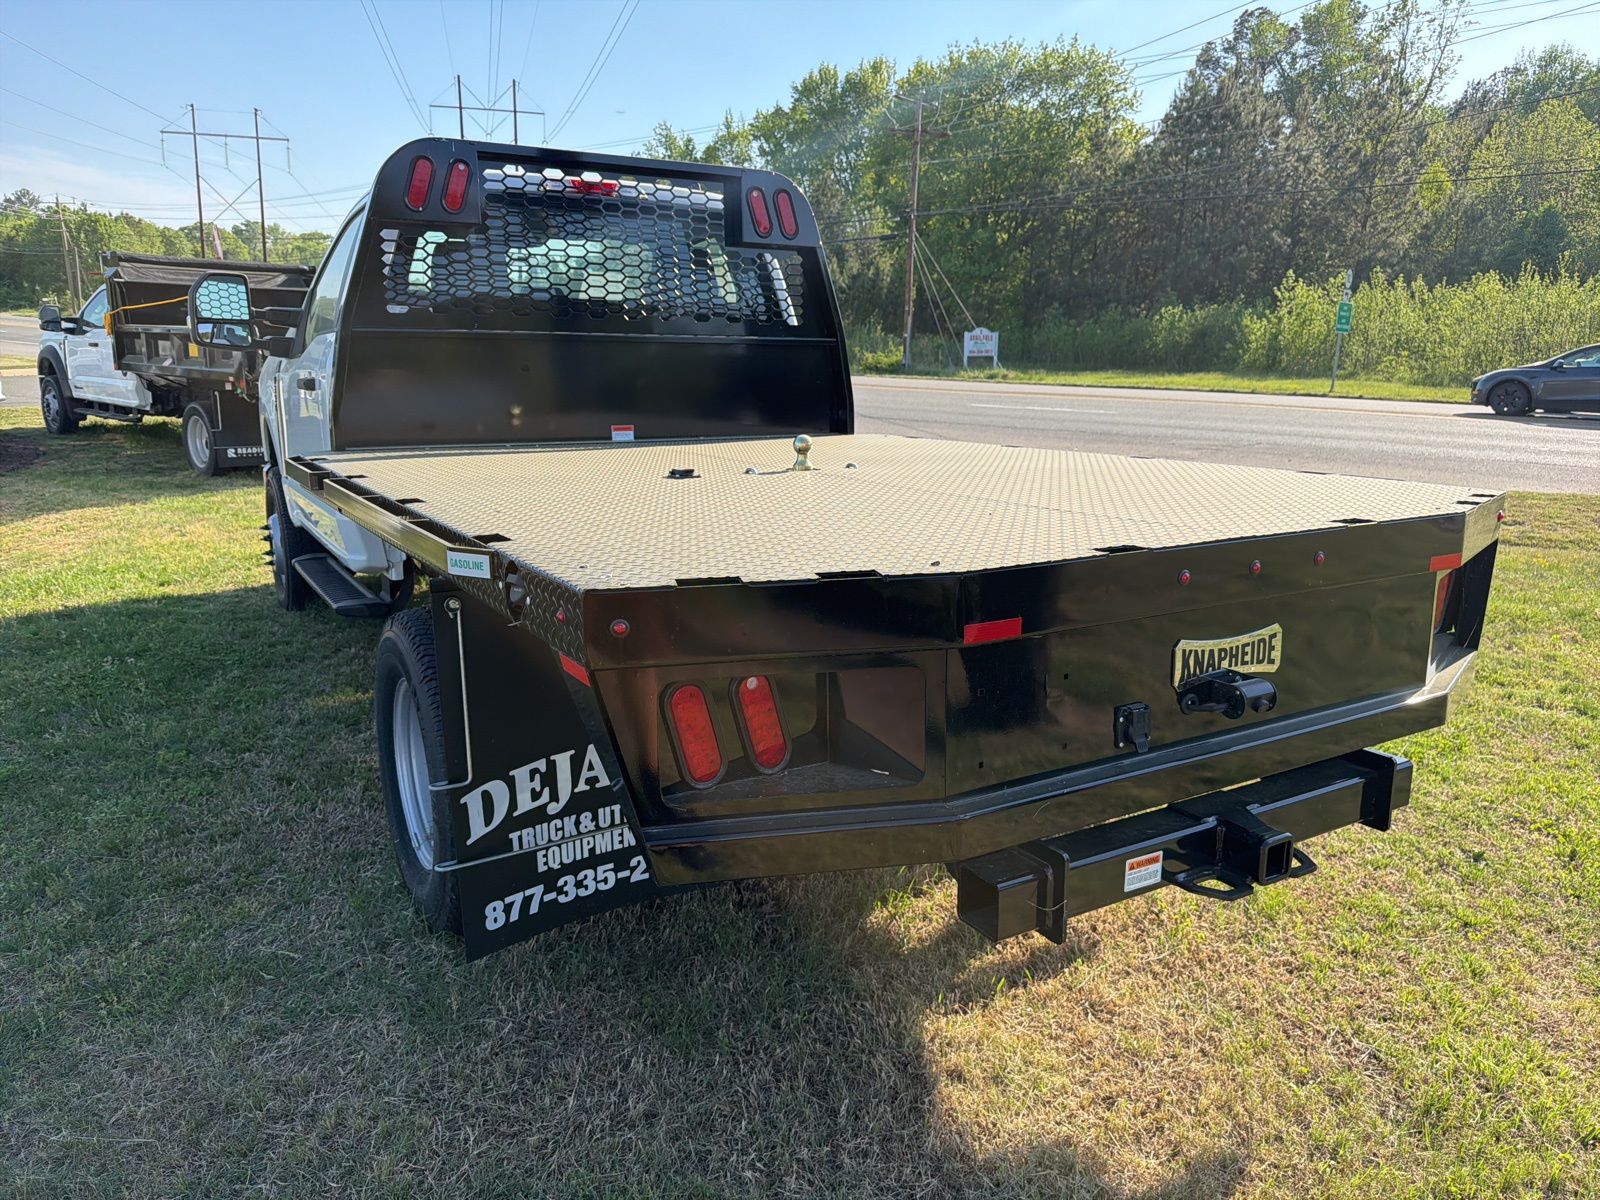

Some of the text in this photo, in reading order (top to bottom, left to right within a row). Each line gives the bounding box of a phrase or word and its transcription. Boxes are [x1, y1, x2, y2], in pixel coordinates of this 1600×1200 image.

[450, 558, 485, 571] GASOLINE
[1180, 632, 1278, 682] KNAPHEIDE
[460, 744, 611, 846] DEJA
[509, 803, 628, 852] TRUCK & UT
[484, 855, 650, 931] 877-335-2
